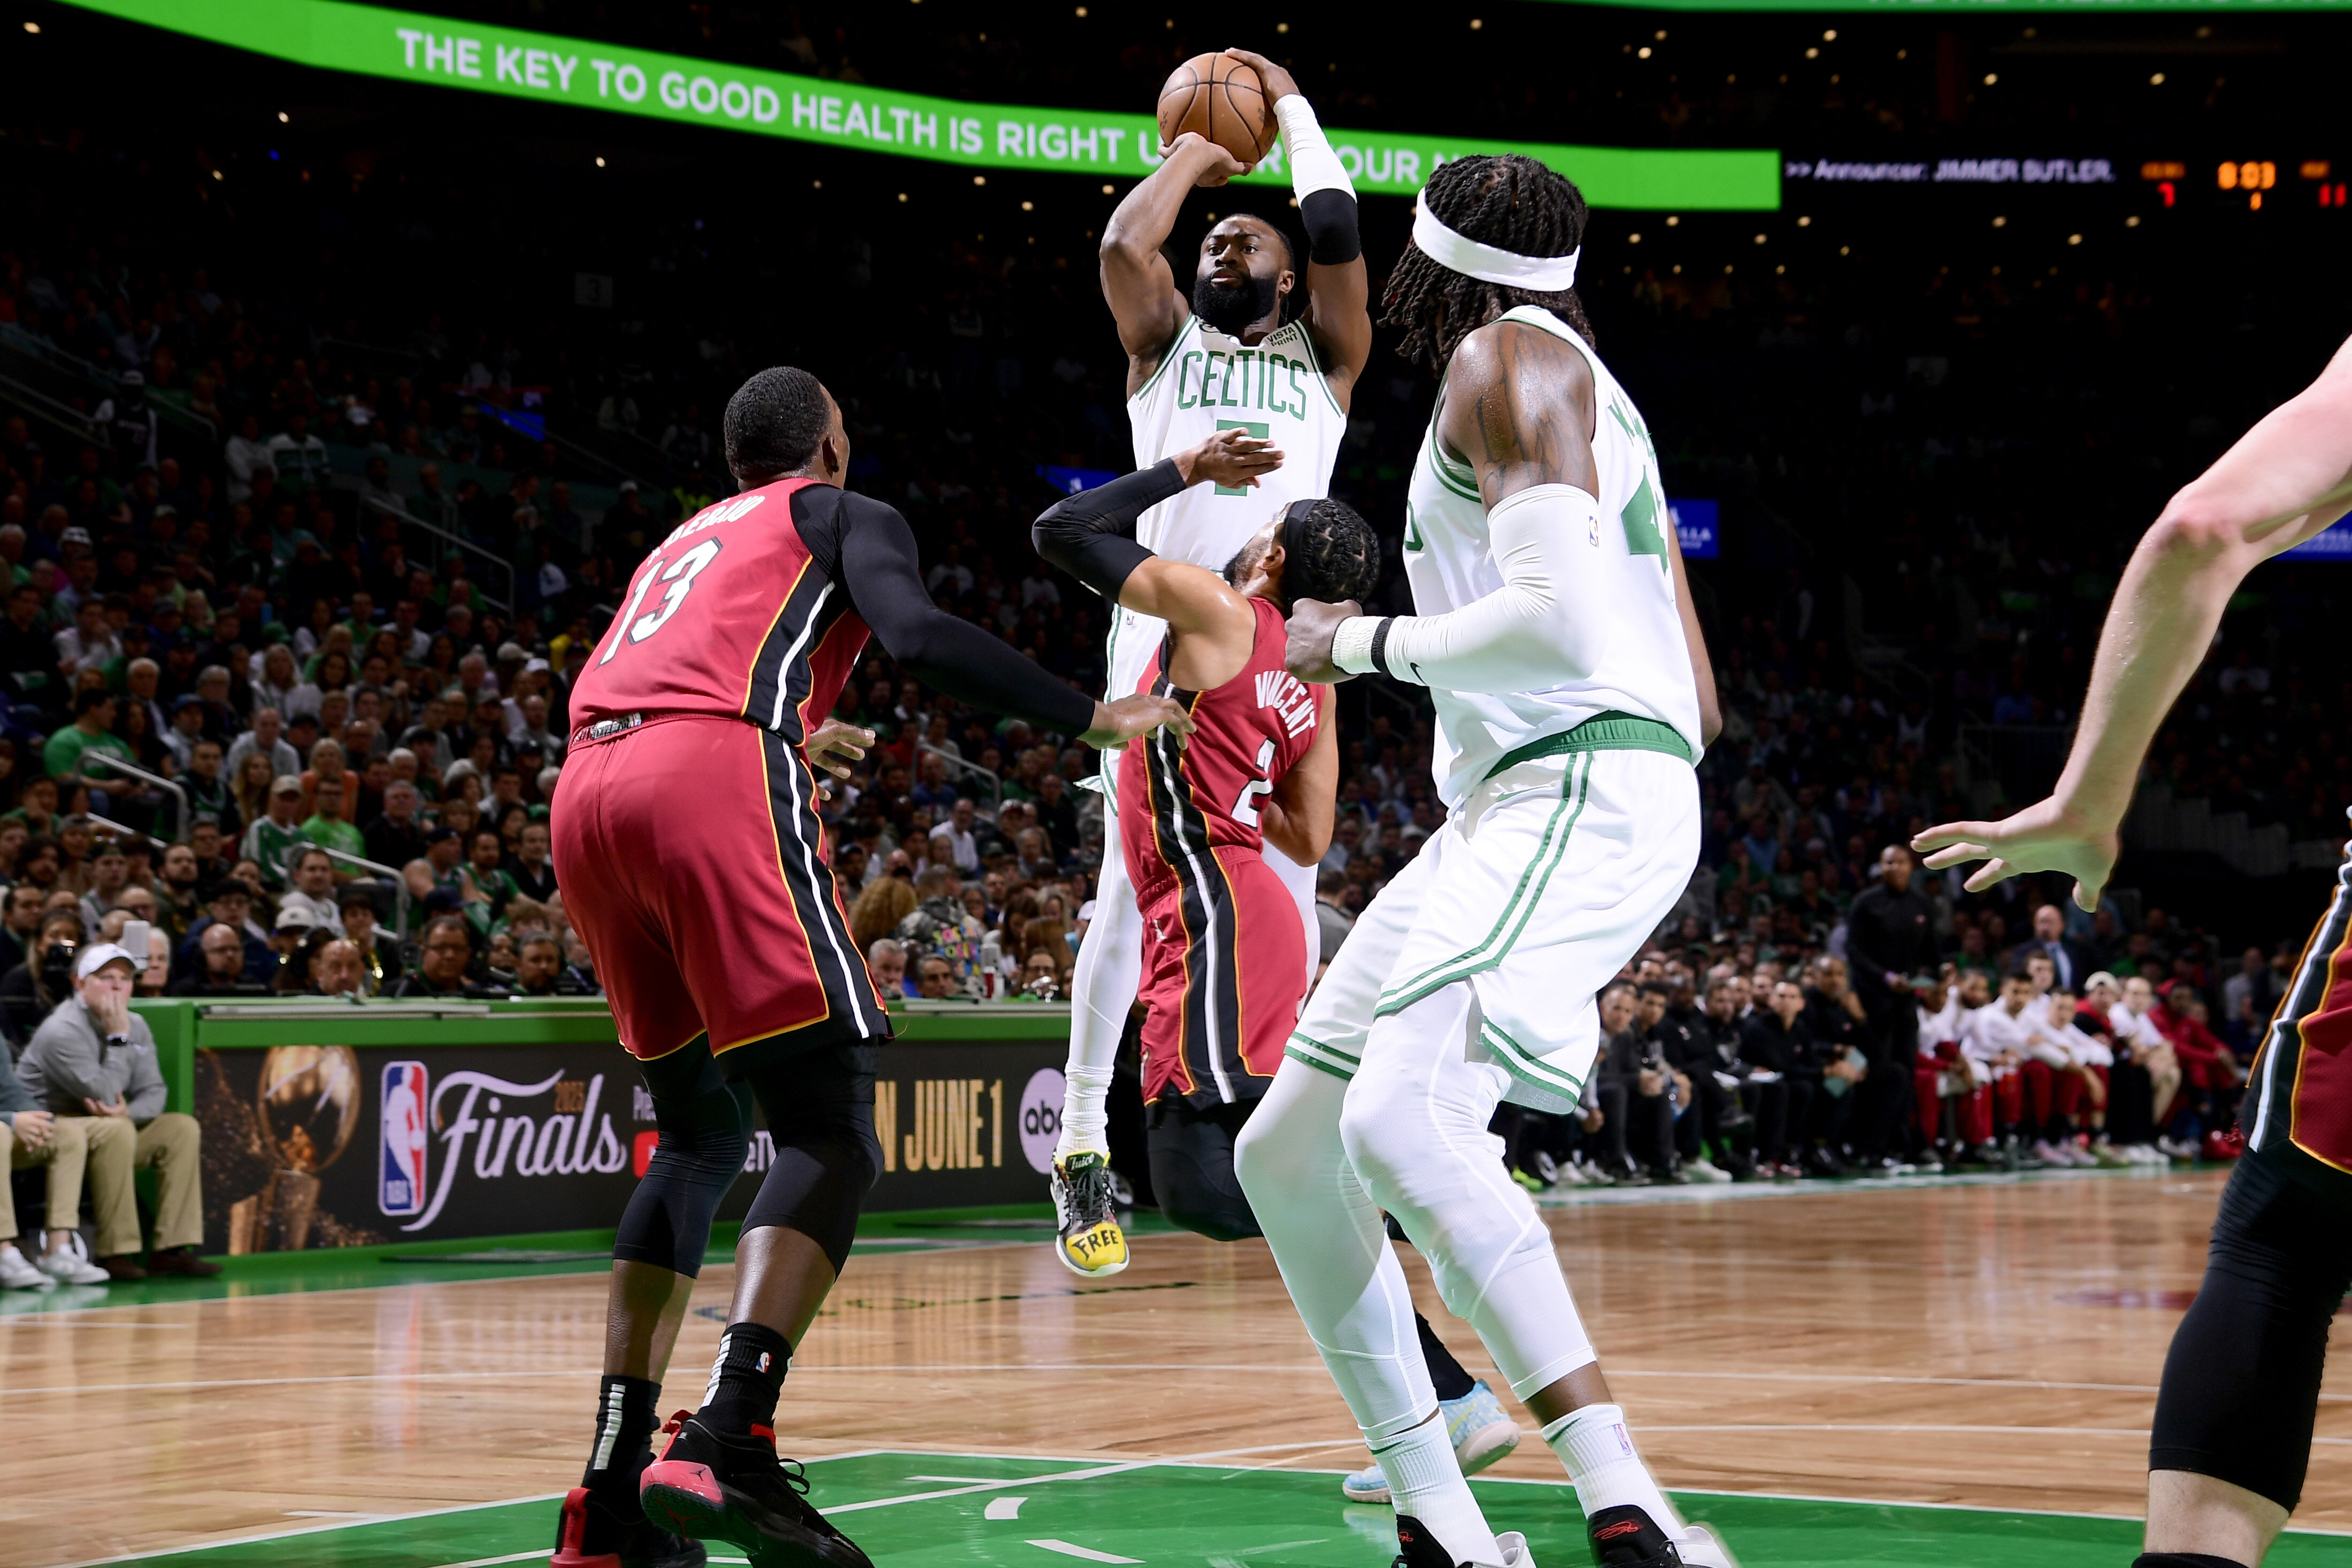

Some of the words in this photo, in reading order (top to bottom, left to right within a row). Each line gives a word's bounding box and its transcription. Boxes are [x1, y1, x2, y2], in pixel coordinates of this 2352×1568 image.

[397, 28, 482, 79] THE
[496, 45, 578, 92] KEY
[591, 59, 647, 102] TO
[659, 72, 780, 123] GOOD
[793, 92, 937, 149] HEALTH
[950, 117, 983, 154] IS
[997, 121, 1126, 163] RIGHT
[1331, 145, 1420, 184] OUR
[1267, 327, 1296, 342] VISTA
[1271, 333, 1297, 347] PRINT
[1178, 350, 1308, 421] CELTICS
[594, 536, 723, 671] 13
[1255, 670, 1316, 739] VINCENT
[1231, 736, 1278, 829] 2
[399, 1069, 627, 1232] Finals
[904, 1079, 984, 1172] JUNE
[990, 1079, 1003, 1167] 1
[1072, 1229, 1119, 1261] FREE
